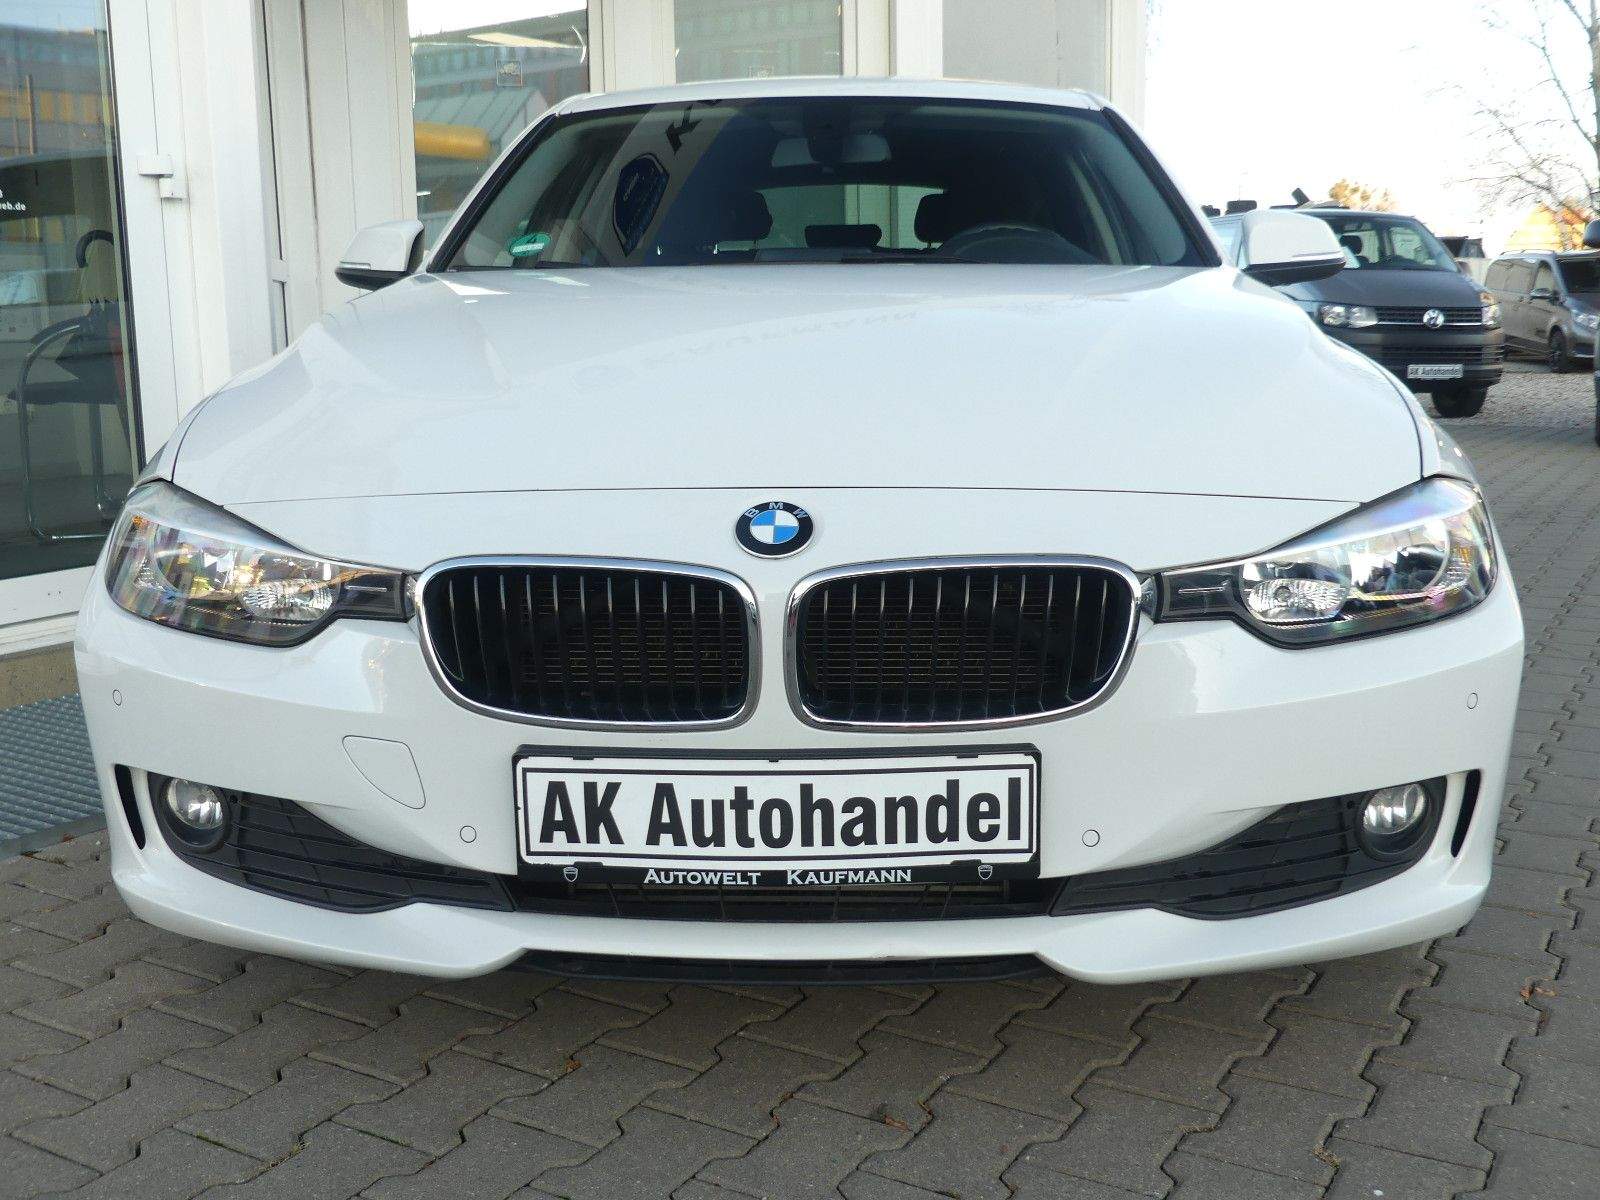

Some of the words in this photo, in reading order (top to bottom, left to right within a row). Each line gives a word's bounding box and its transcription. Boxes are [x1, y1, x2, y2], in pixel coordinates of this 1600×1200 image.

[0, 201, 26, 210] eb.de
[744, 502, 808, 518] BMW
[539, 781, 624, 845] AK
[645, 777, 1022, 849] Autohandel
[643, 868, 762, 885] AUTOWELT
[786, 868, 912, 884] KAUFMANN
